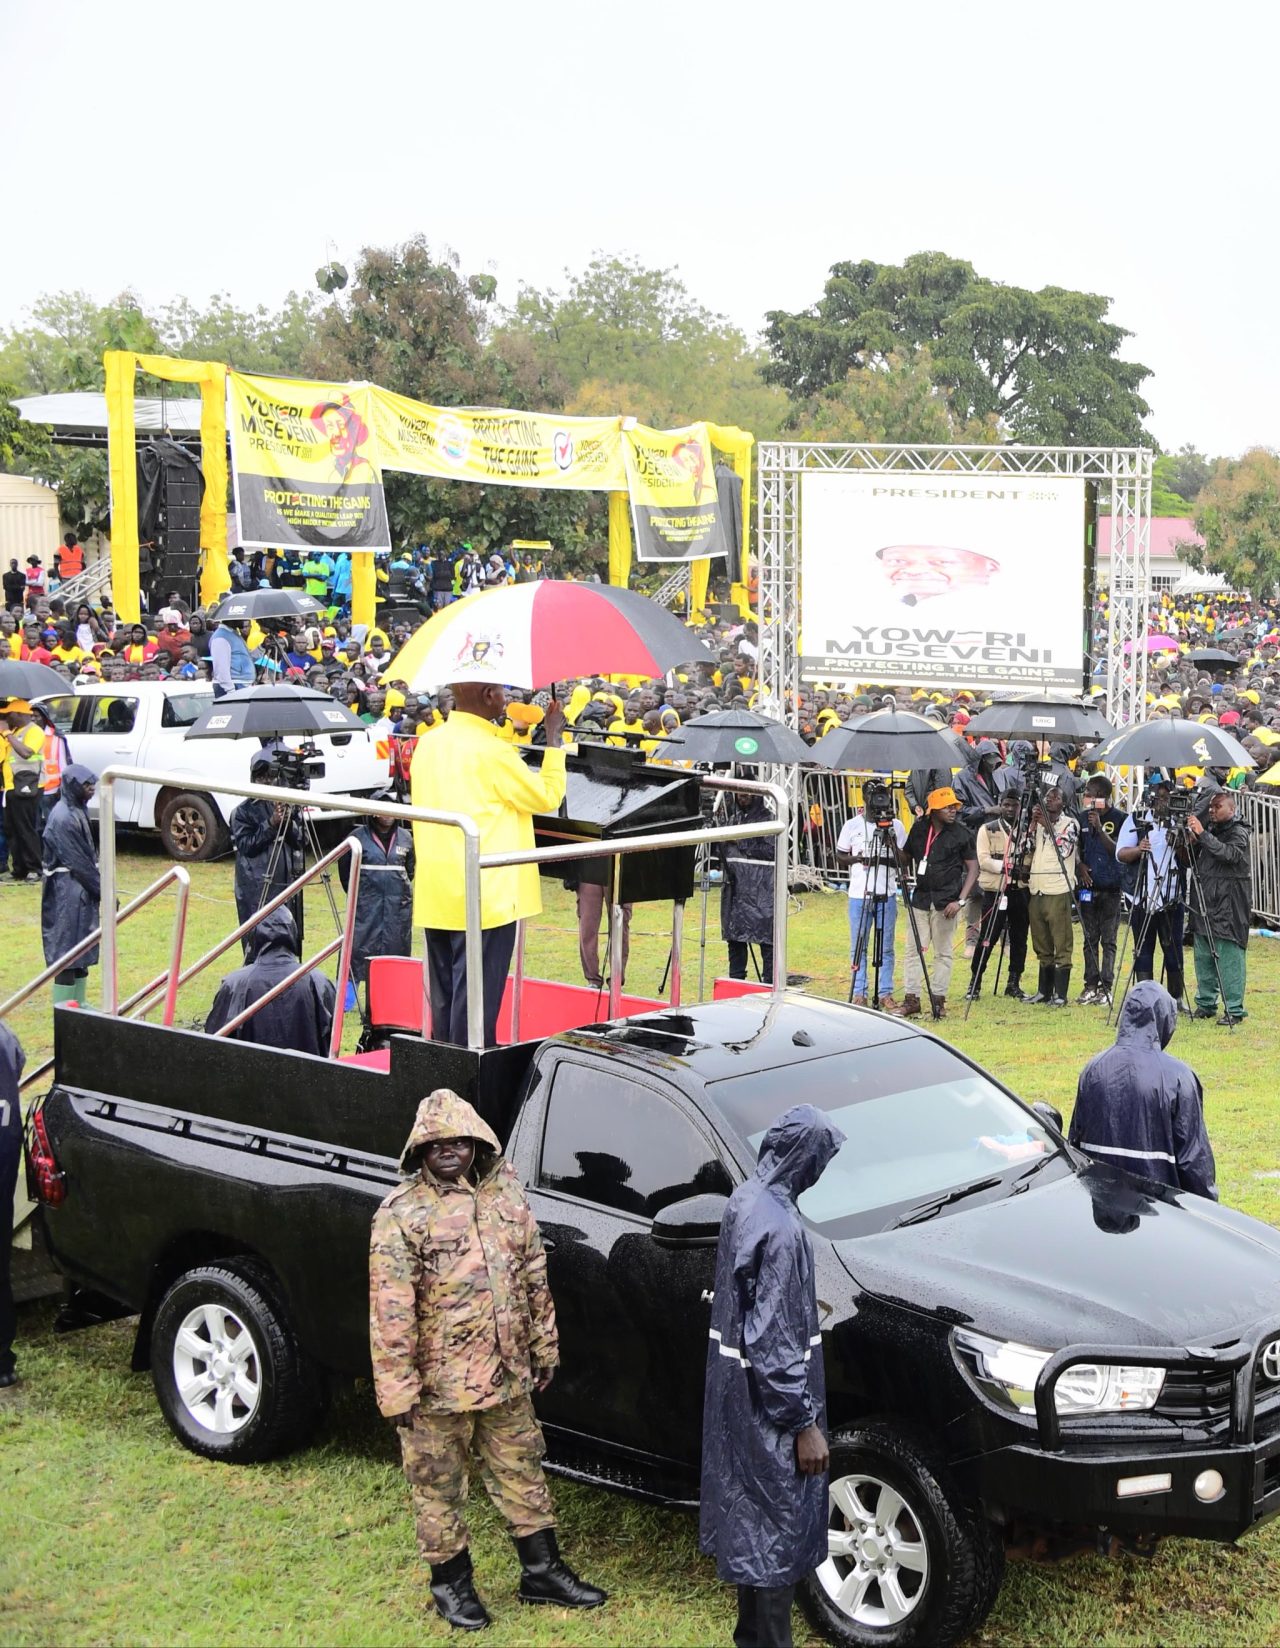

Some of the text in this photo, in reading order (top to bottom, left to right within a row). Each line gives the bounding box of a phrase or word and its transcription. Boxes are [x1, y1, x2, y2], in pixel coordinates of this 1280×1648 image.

[240, 414, 318, 444] MUSEVENI
[472, 418, 542, 446] PROTECTING
[249, 437, 300, 457] PRESIDENT
[483, 446, 540, 476] THE GAINS
[264, 489, 371, 510] PROTECTING THE GAINS
[872, 487, 1023, 500] PRESIDENT
[825, 639, 1052, 664] MUSEVENI
[824, 658, 1055, 677] PROTECTING THE GAINS
